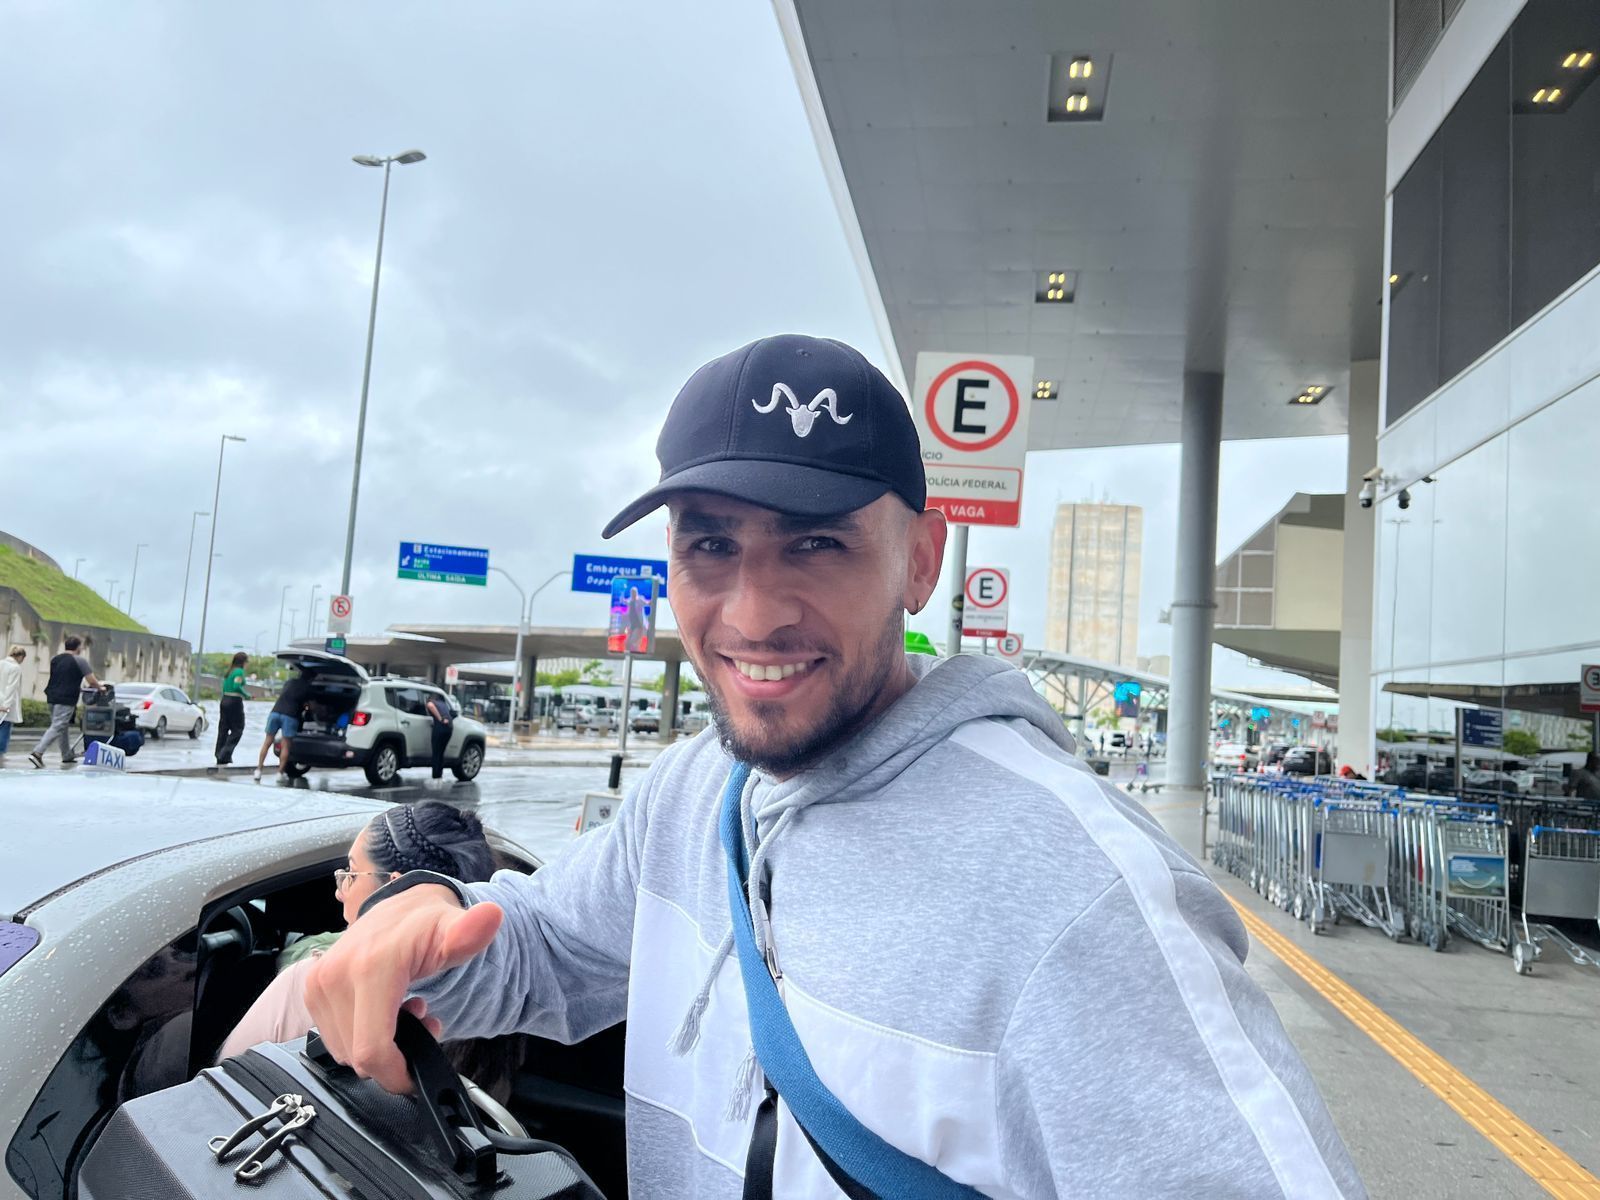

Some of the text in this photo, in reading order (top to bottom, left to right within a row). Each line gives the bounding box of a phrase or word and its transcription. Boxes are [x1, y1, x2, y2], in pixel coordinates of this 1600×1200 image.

[953, 378, 989, 435] E
[922, 450, 943, 460] ÍCIO
[926, 476, 960, 487] OLÍCIA
[950, 504, 985, 518] VAGA
[586, 563, 637, 576] Embarque
[586, 575, 612, 586] Depa
[979, 577, 993, 599] E
[1005, 638, 1014, 652] E
[100, 747, 124, 770] TAXI
